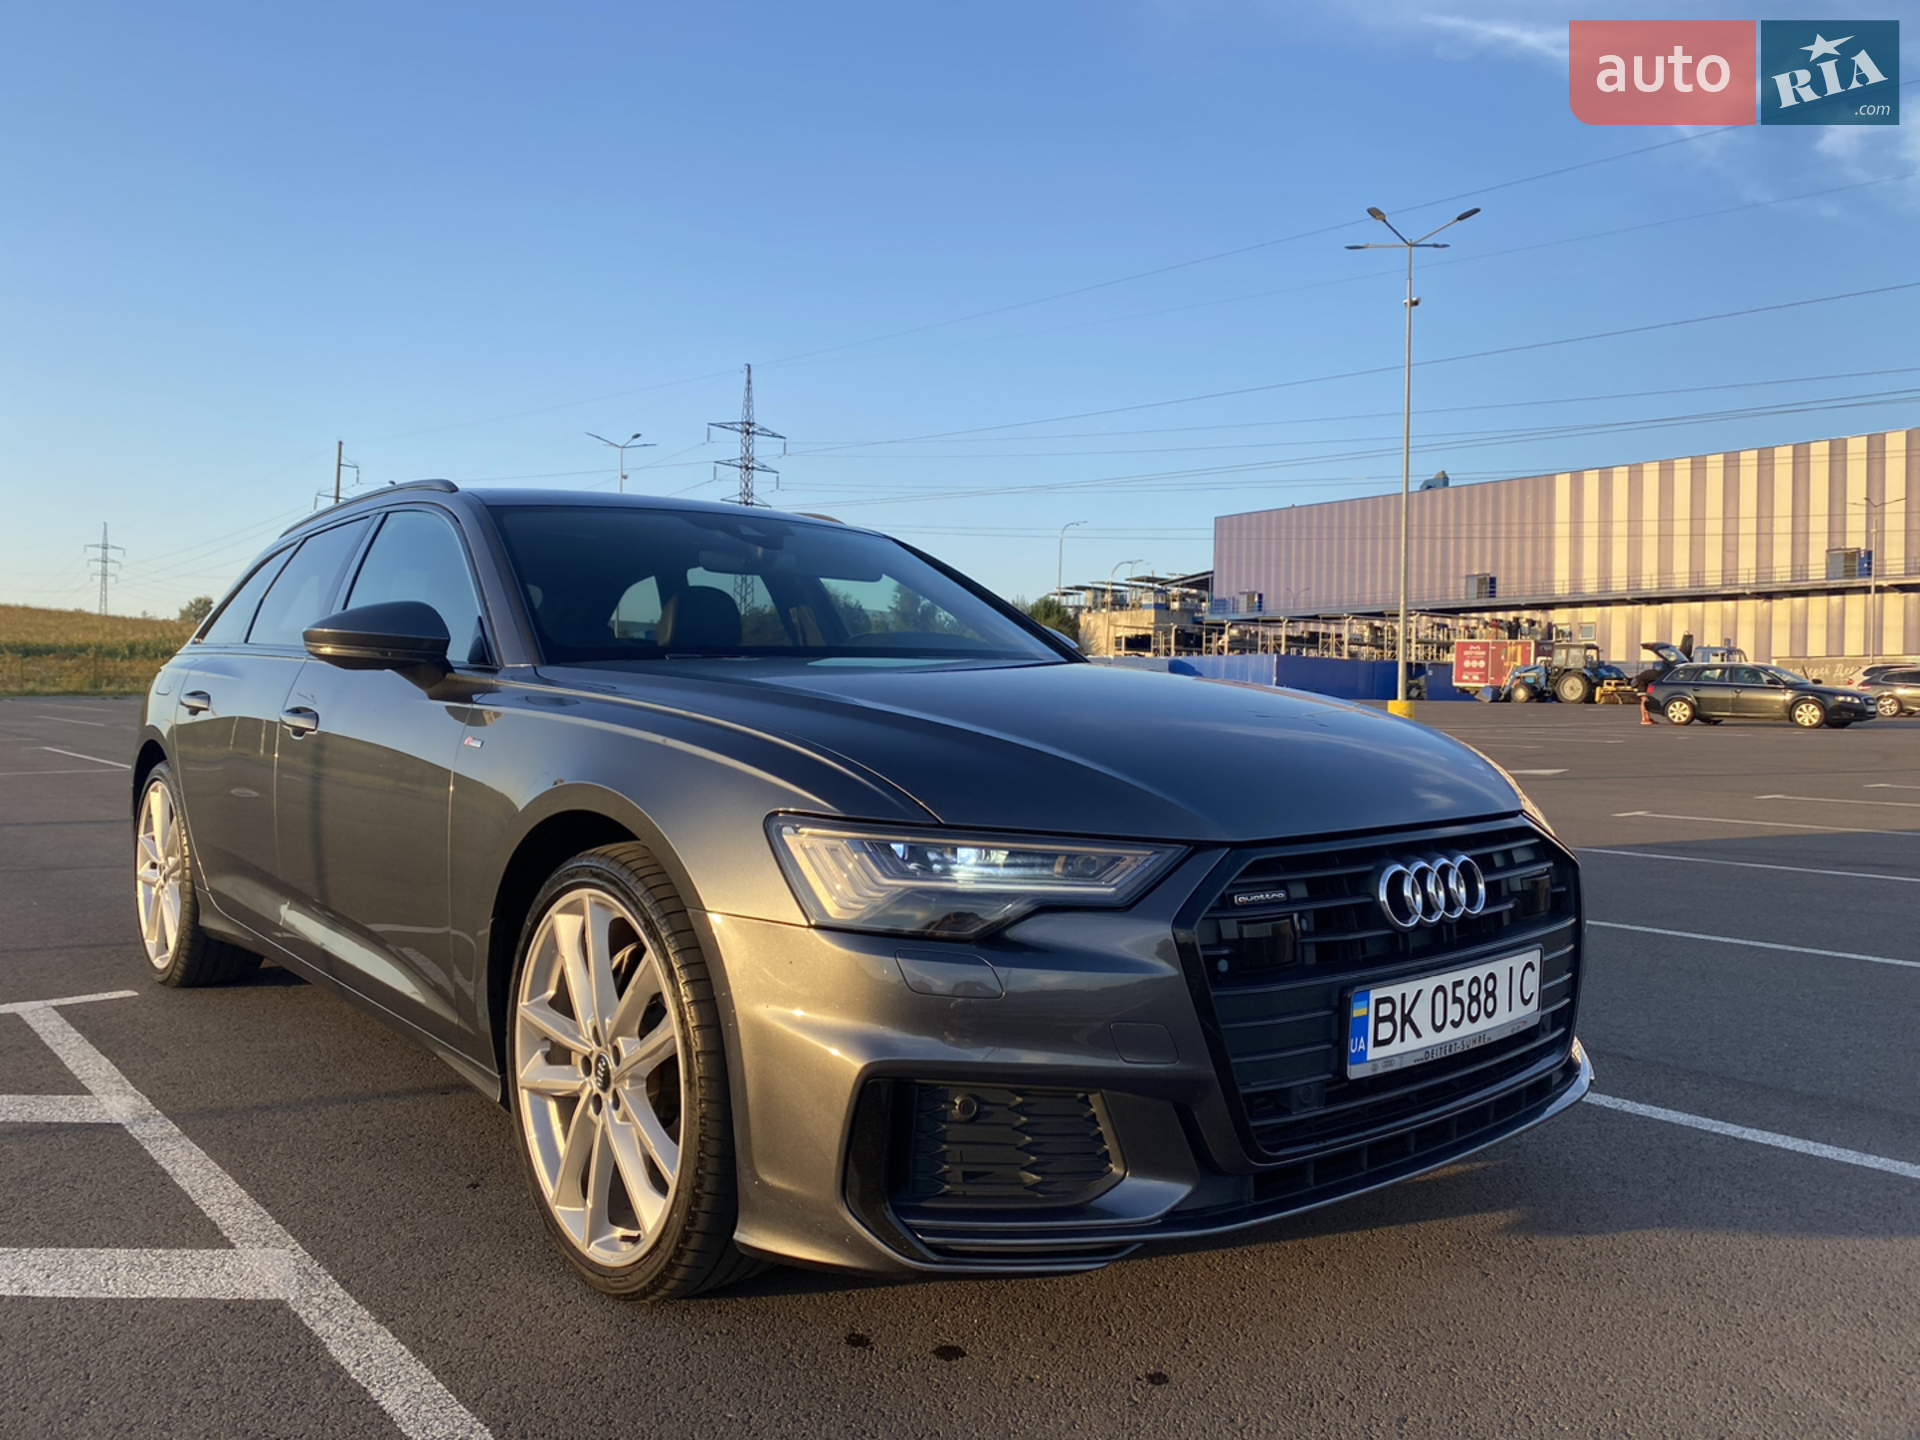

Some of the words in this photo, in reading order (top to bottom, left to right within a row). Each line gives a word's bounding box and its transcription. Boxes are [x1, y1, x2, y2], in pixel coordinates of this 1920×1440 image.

[1238, 892, 1284, 904] quattro
[1373, 989, 1424, 1048] BK
[1431, 971, 1498, 1033] 0588
[1508, 961, 1536, 1013] IC
[1350, 1036, 1366, 1053] UA
